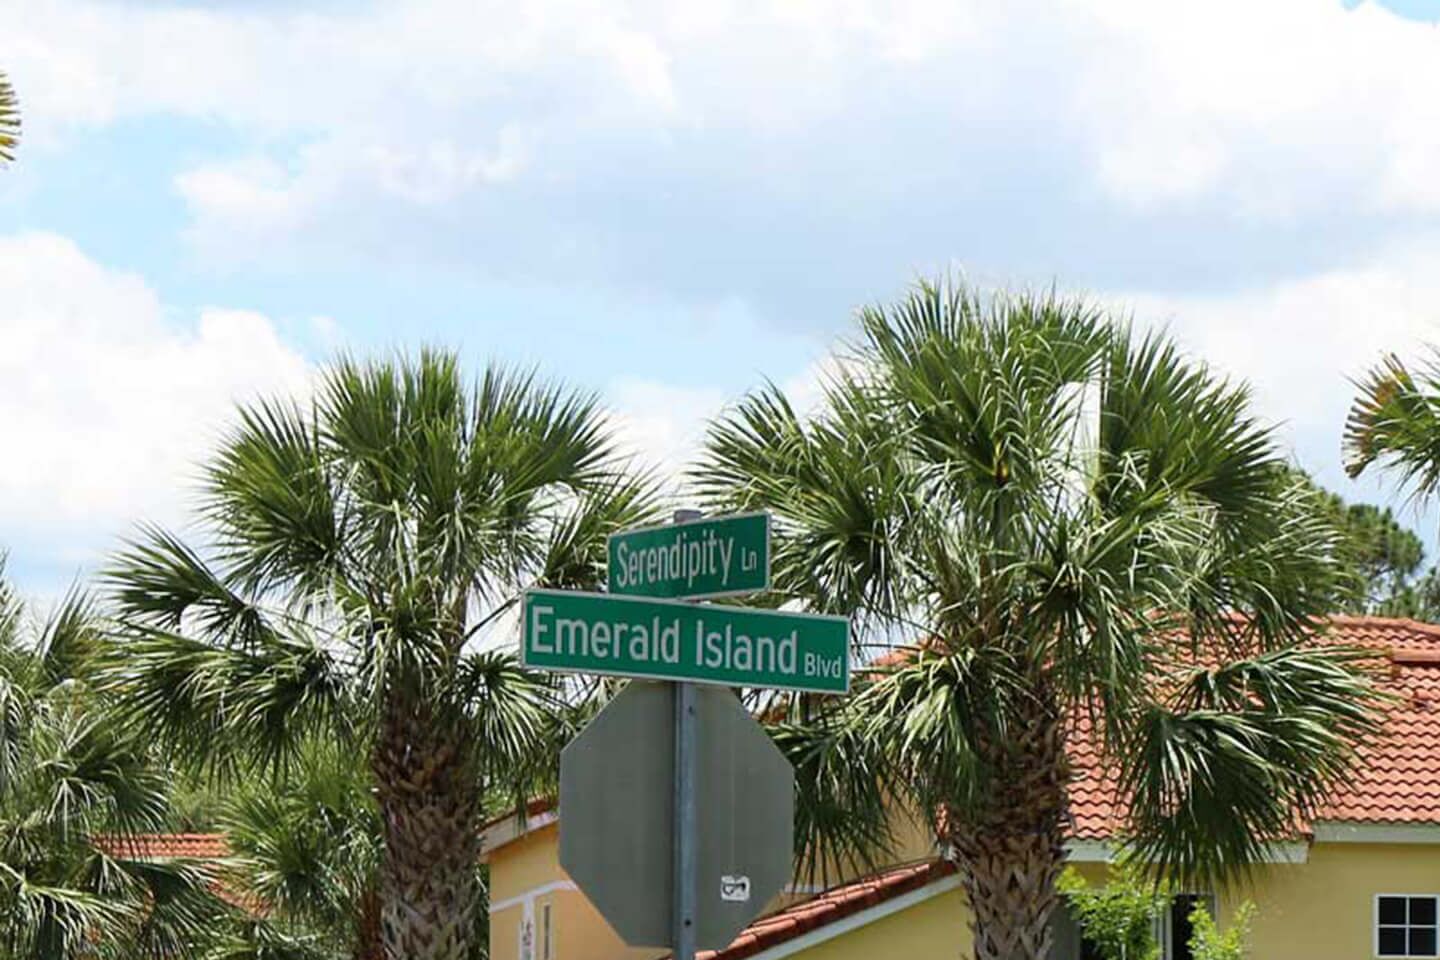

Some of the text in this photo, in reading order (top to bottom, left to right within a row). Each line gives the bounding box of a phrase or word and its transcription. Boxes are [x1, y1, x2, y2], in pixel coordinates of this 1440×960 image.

[617, 529, 757, 588] Serendipity Ln
[531, 606, 841, 679] Emerald Island Blvd
